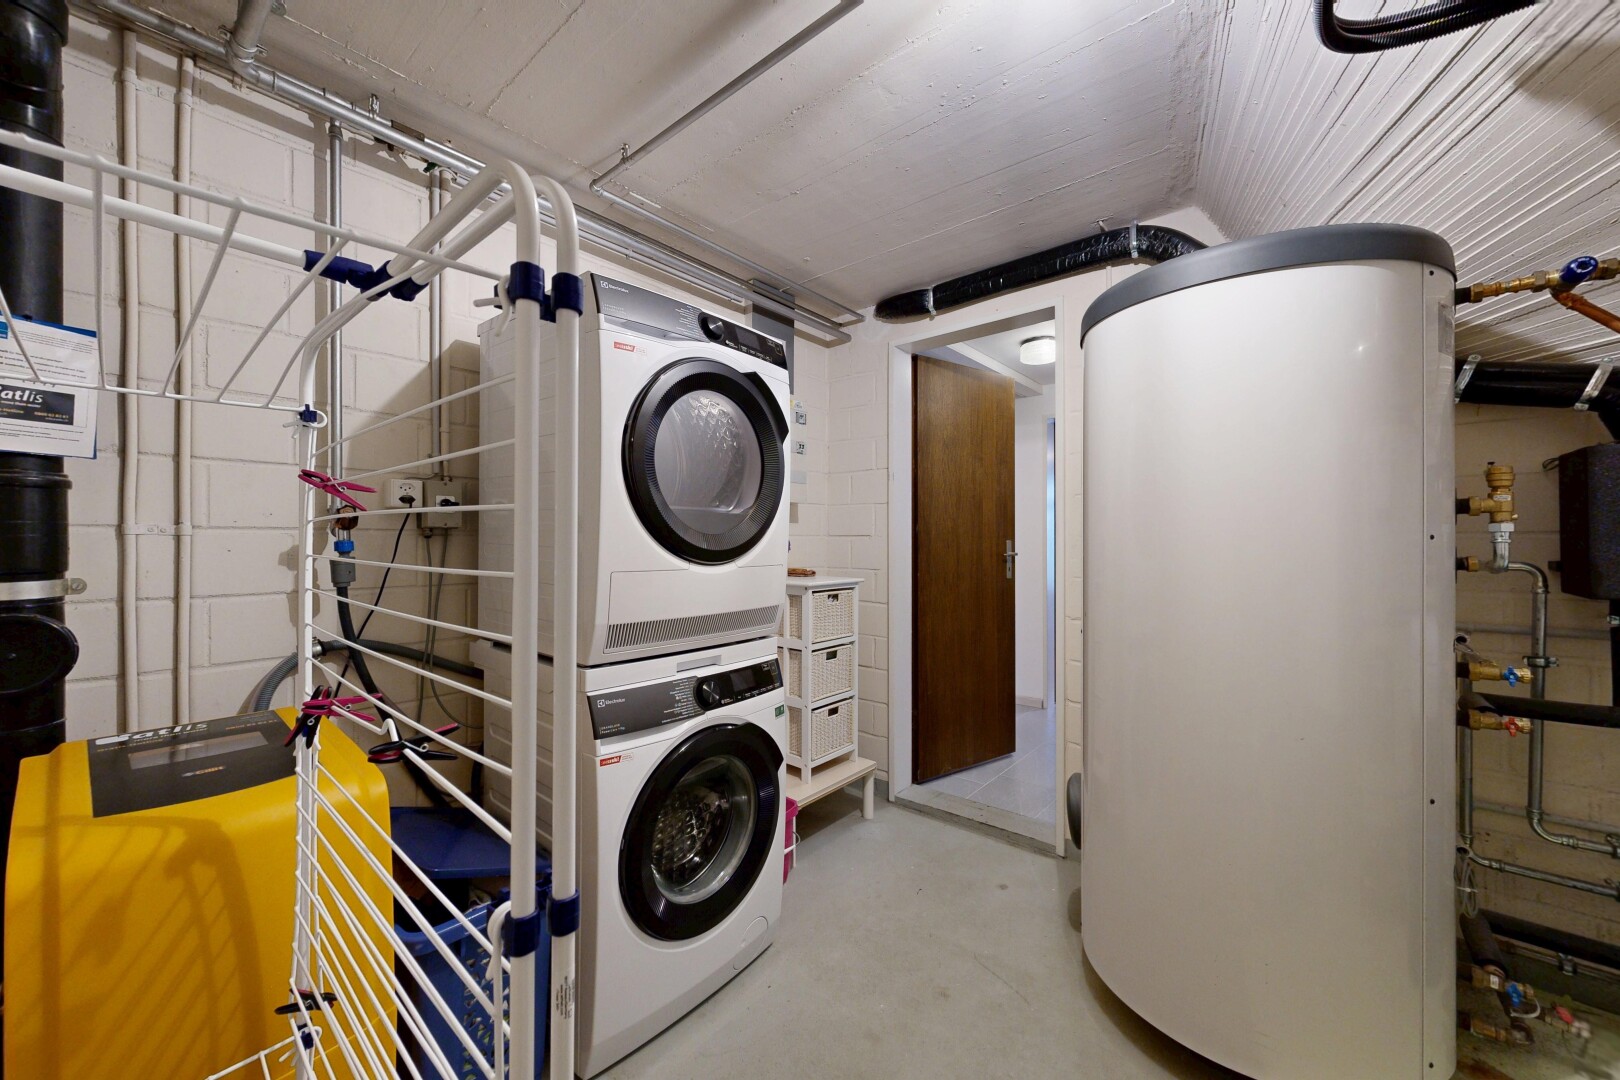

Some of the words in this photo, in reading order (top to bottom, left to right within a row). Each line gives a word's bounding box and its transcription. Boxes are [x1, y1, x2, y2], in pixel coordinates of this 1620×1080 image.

[608, 283, 629, 293] Electrolux
[0, 385, 44, 403] atlis
[605, 697, 626, 705] Electrolux
